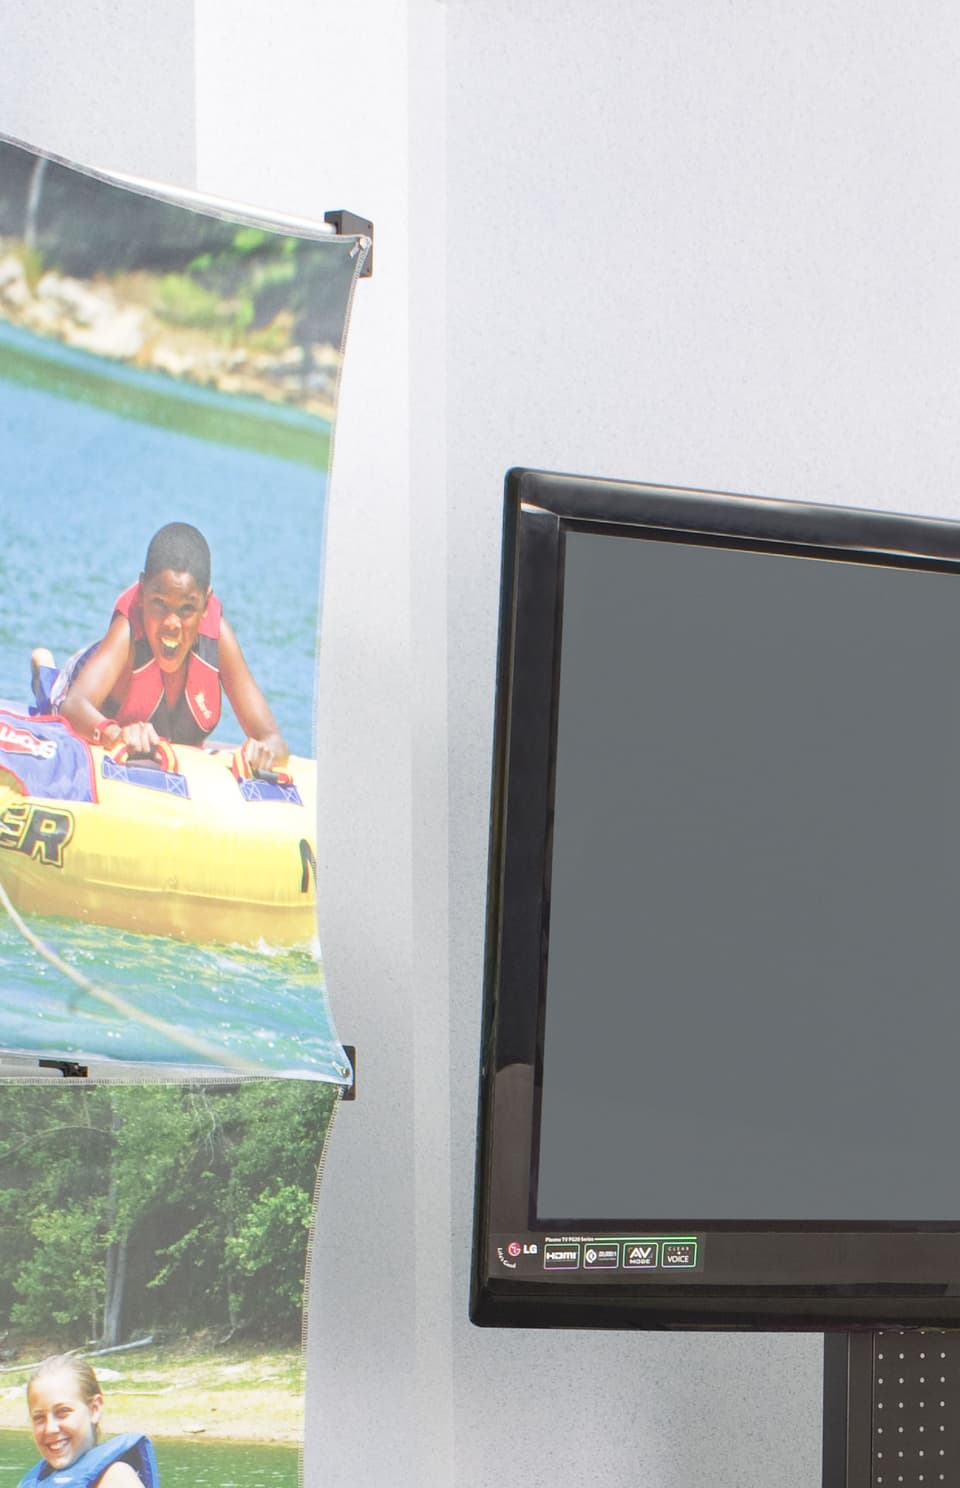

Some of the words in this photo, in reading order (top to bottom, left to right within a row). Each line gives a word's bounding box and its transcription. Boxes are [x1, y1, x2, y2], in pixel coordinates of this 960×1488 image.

[546, 1251, 577, 1260] HDMI
[629, 1247, 652, 1258] AV
[667, 1255, 689, 1263] VOICE
